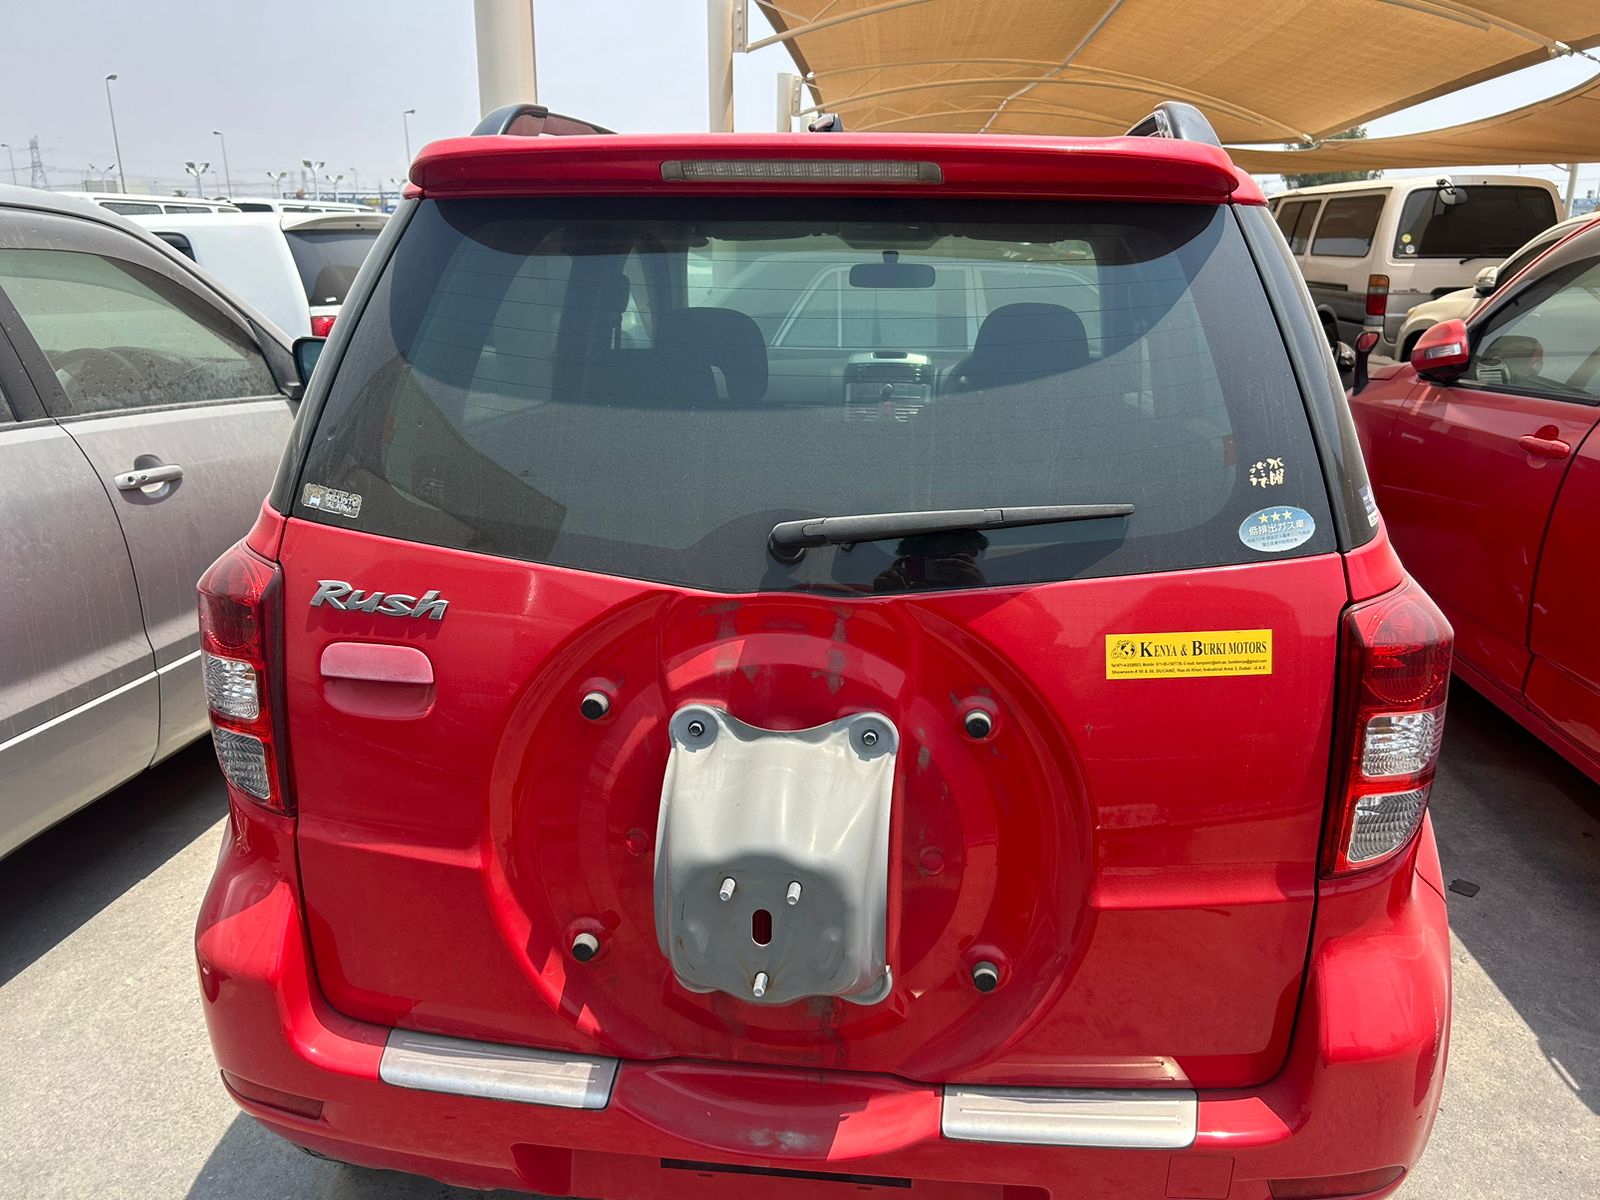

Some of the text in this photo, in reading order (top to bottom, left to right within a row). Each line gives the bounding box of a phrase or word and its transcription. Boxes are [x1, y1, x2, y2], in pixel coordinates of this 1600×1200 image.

[1248, 519, 1305, 537] 低排出ガス車
[310, 579, 450, 620] Rush
[1140, 640, 1267, 657] KENYA & BURKI MOTORS
